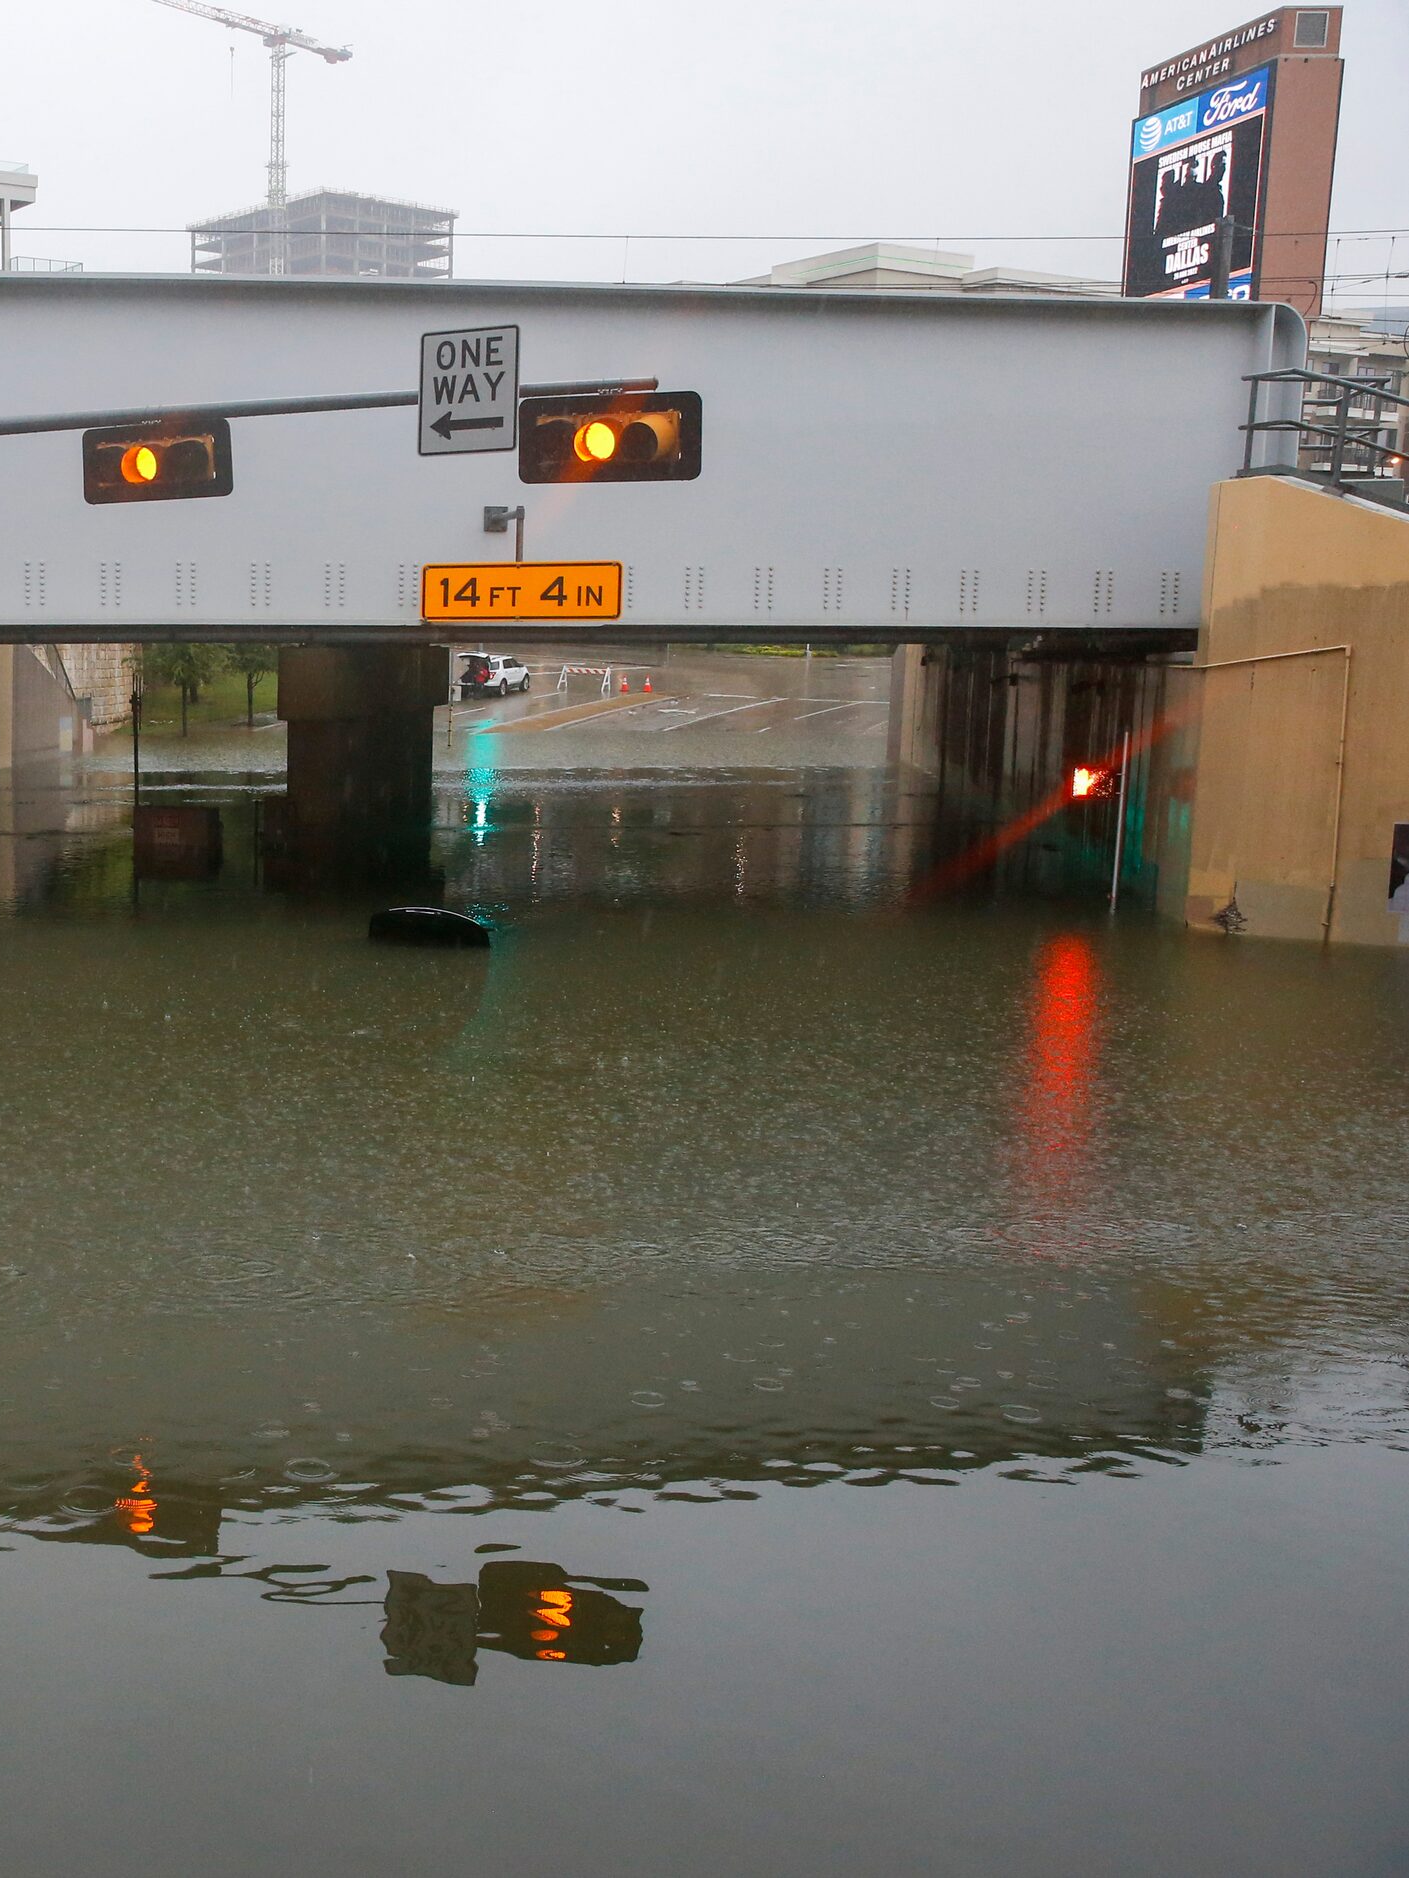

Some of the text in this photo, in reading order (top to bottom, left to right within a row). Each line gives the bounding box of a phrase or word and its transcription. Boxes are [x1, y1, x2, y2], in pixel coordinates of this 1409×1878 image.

[1176, 58, 1231, 91] CENTER
[1203, 80, 1261, 126] Ford
[1164, 110, 1194, 136] AT&T
[1189, 139, 1211, 157] HOUSE
[1211, 130, 1233, 148] MAFIA
[1165, 242, 1210, 275] DALLAS
[436, 336, 504, 371] ONE
[433, 371, 505, 405] WAY
[440, 576, 603, 608] 14 FT 4 IN
